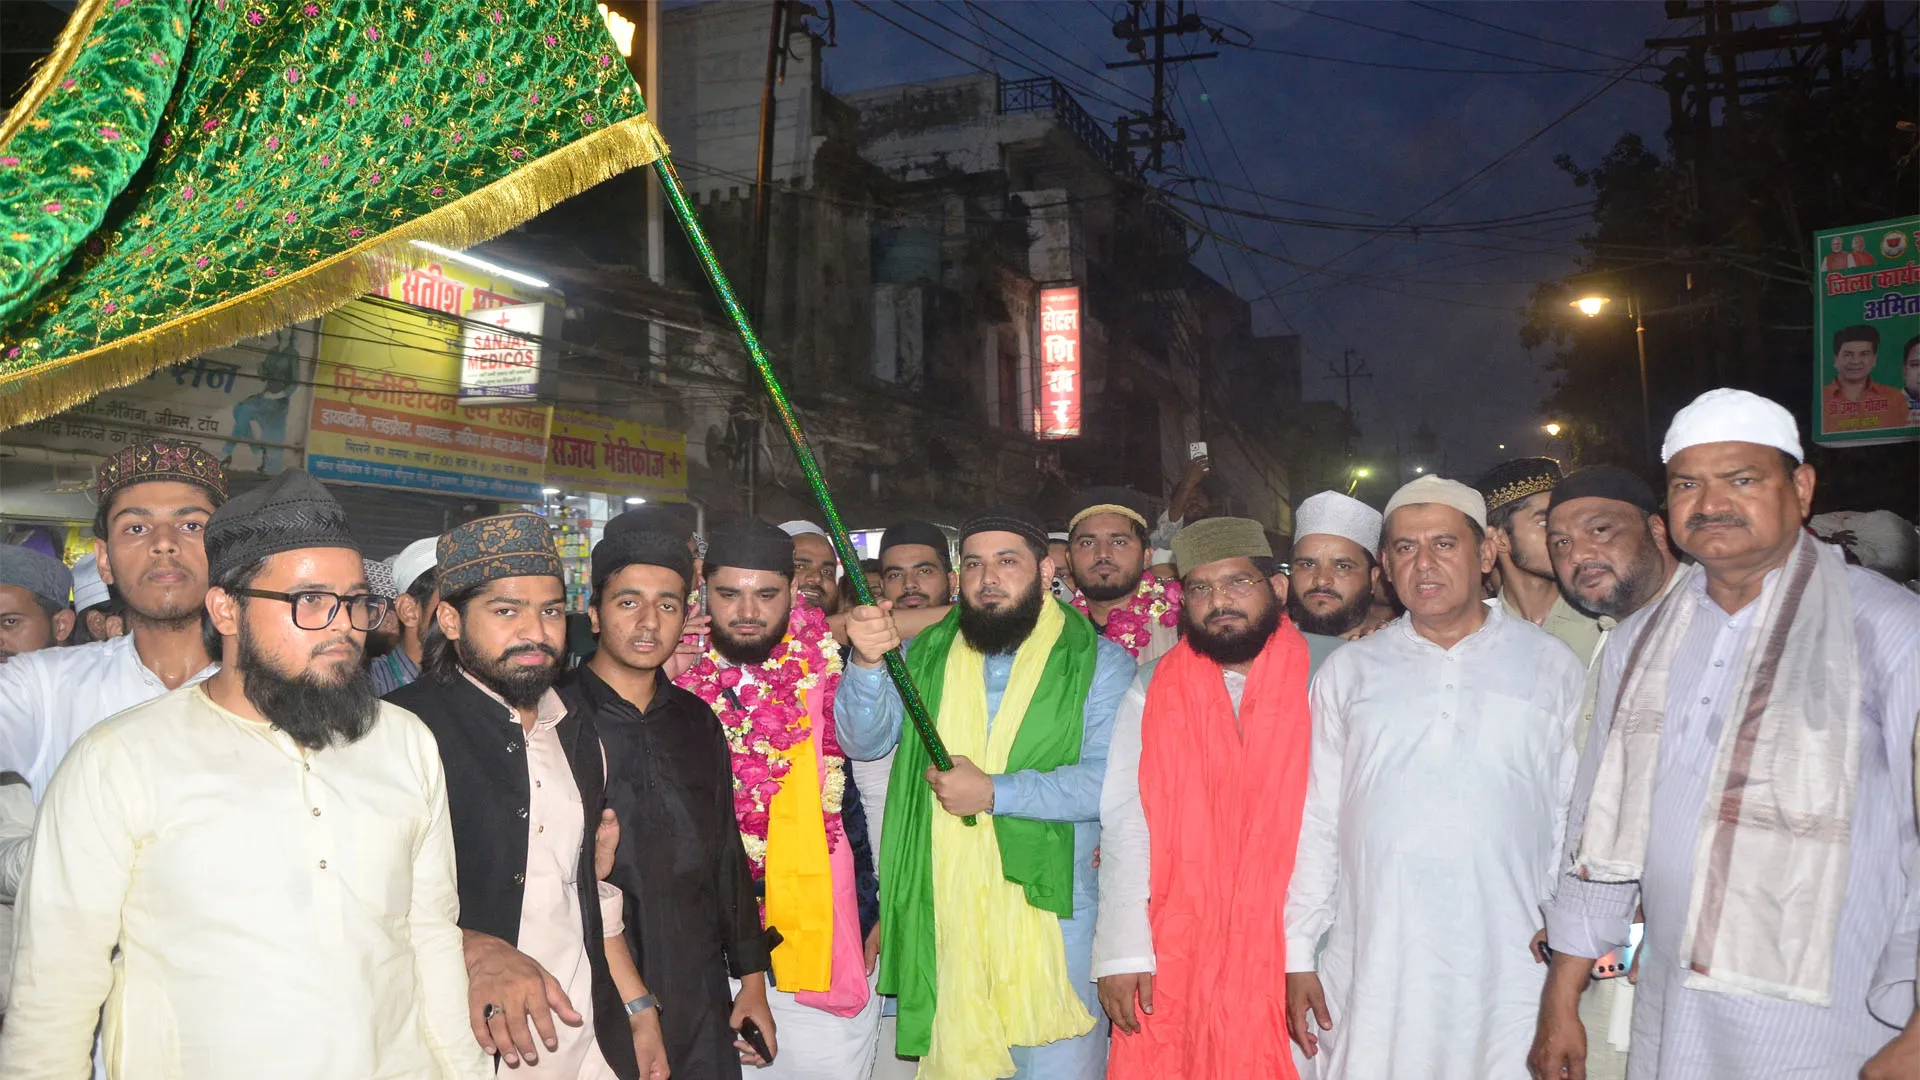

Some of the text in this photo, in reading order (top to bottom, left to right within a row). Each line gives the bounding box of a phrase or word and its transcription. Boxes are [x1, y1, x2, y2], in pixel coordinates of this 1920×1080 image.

[1826, 271, 1872, 295] जिला
[1041, 306, 1078, 332] होटल
[474, 334, 527, 351] SANJAY
[467, 350, 533, 370] MEDICOS
[197, 415, 219, 433] टॉप
[110, 430, 127, 443] का
[551, 427, 597, 469] संजय
